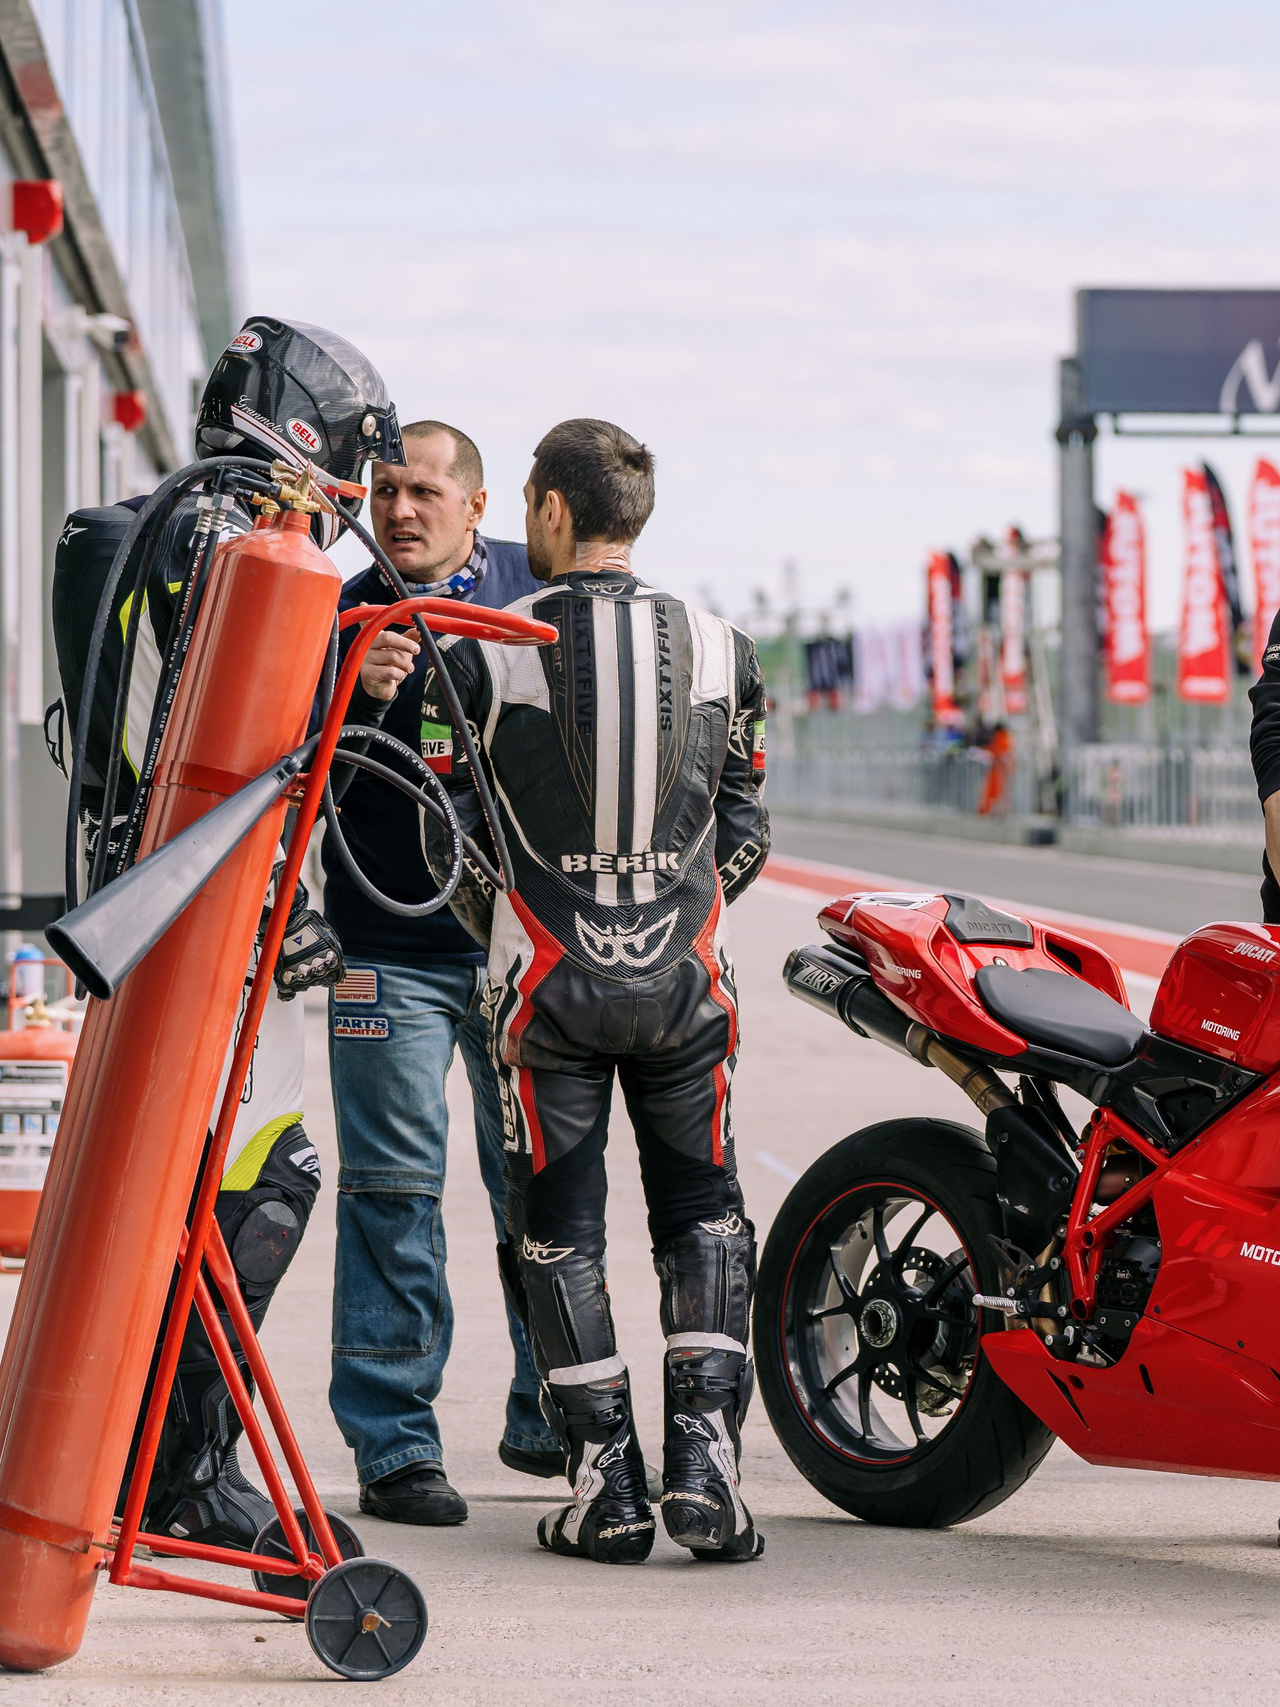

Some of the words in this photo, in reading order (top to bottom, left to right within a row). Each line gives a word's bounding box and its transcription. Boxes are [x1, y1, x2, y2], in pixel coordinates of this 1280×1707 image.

[291, 421, 317, 448] BELL
[553, 615, 564, 673] laer
[574, 600, 593, 735] SIXTYFIVE
[654, 600, 673, 732] SIXTYFIVE
[115, 860, 123, 873] bar
[965, 921, 1012, 934] DUCATI
[1233, 941, 1277, 963] DUCATI
[884, 960, 922, 979] MOTORING
[335, 1018, 387, 1029] PARTS
[335, 1028, 386, 1036] UNLIMITED
[1201, 1019, 1240, 1041] MOTORING
